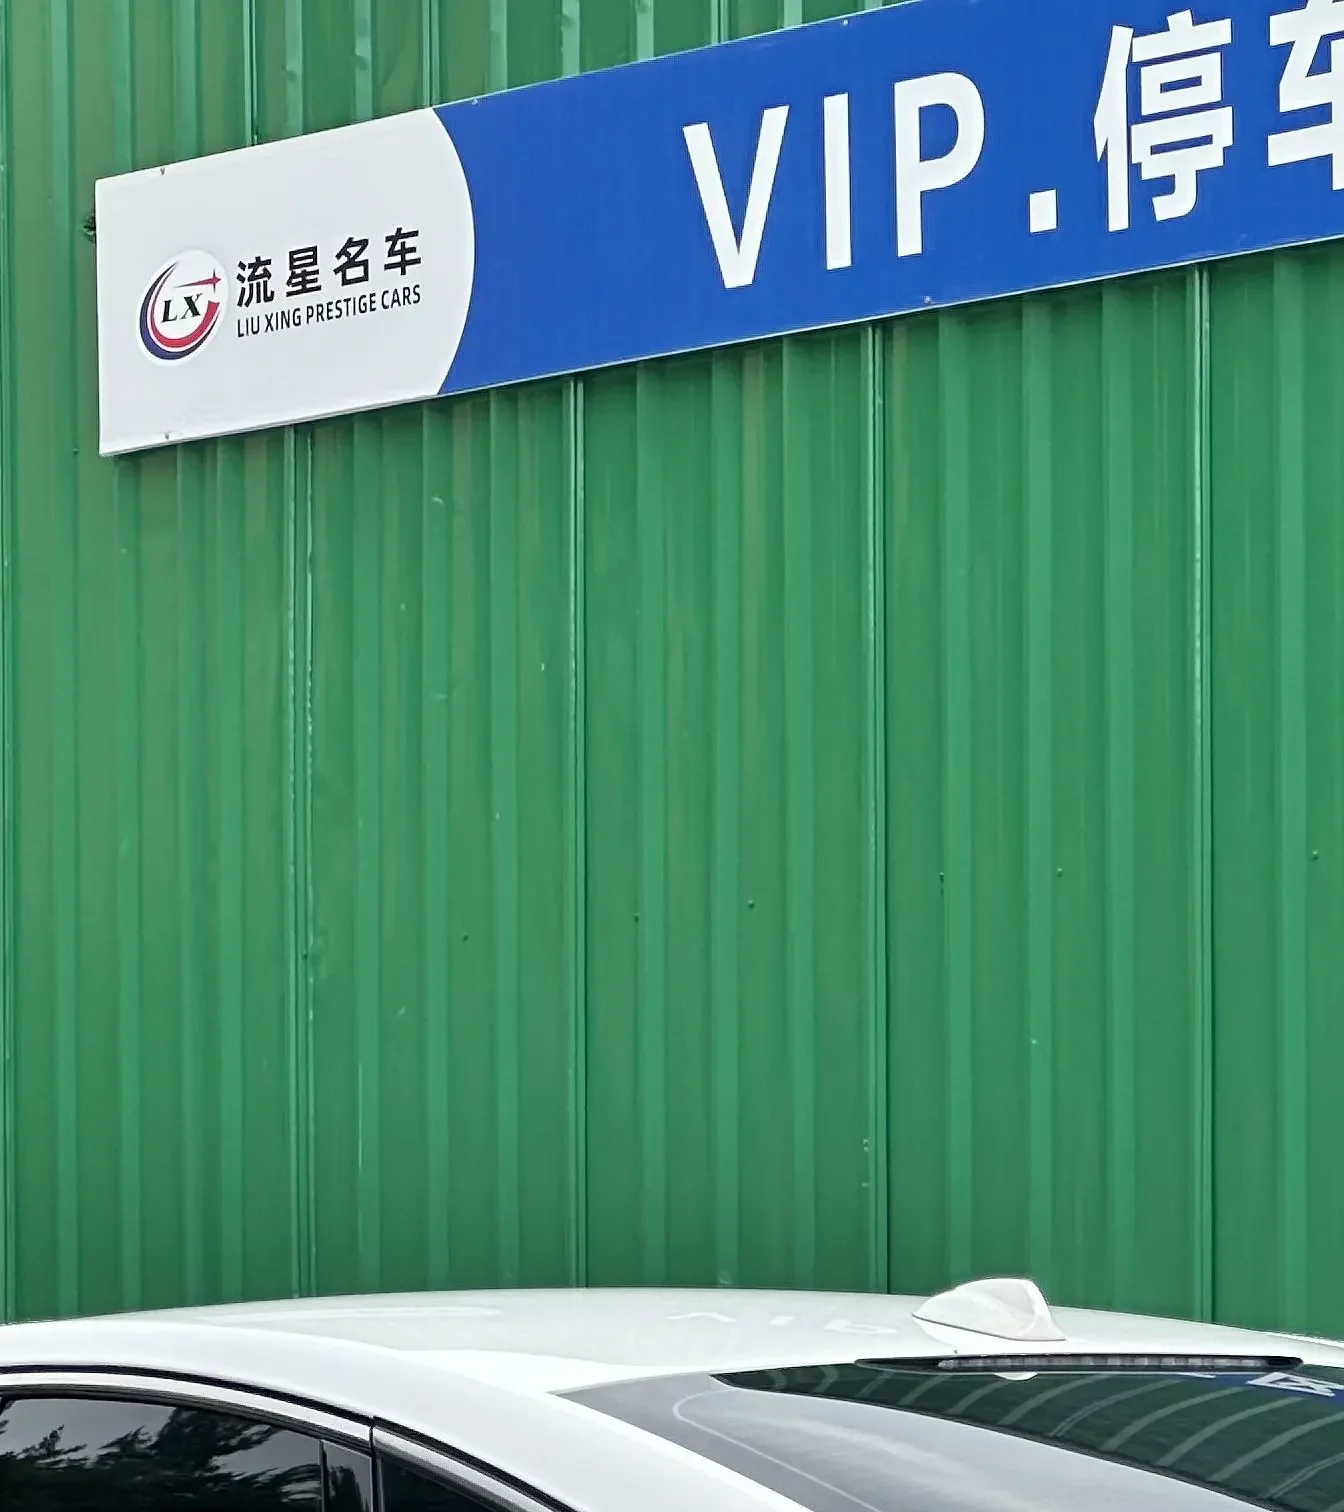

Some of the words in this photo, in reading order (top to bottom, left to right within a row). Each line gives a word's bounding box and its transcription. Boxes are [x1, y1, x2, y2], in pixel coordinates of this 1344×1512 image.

[235, 226, 422, 308] 流星名车
[159, 292, 206, 325] LX
[236, 315, 261, 338] LIU
[263, 307, 303, 334] XING
[305, 294, 378, 324] PRESTIGE
[380, 284, 422, 310] CARS
